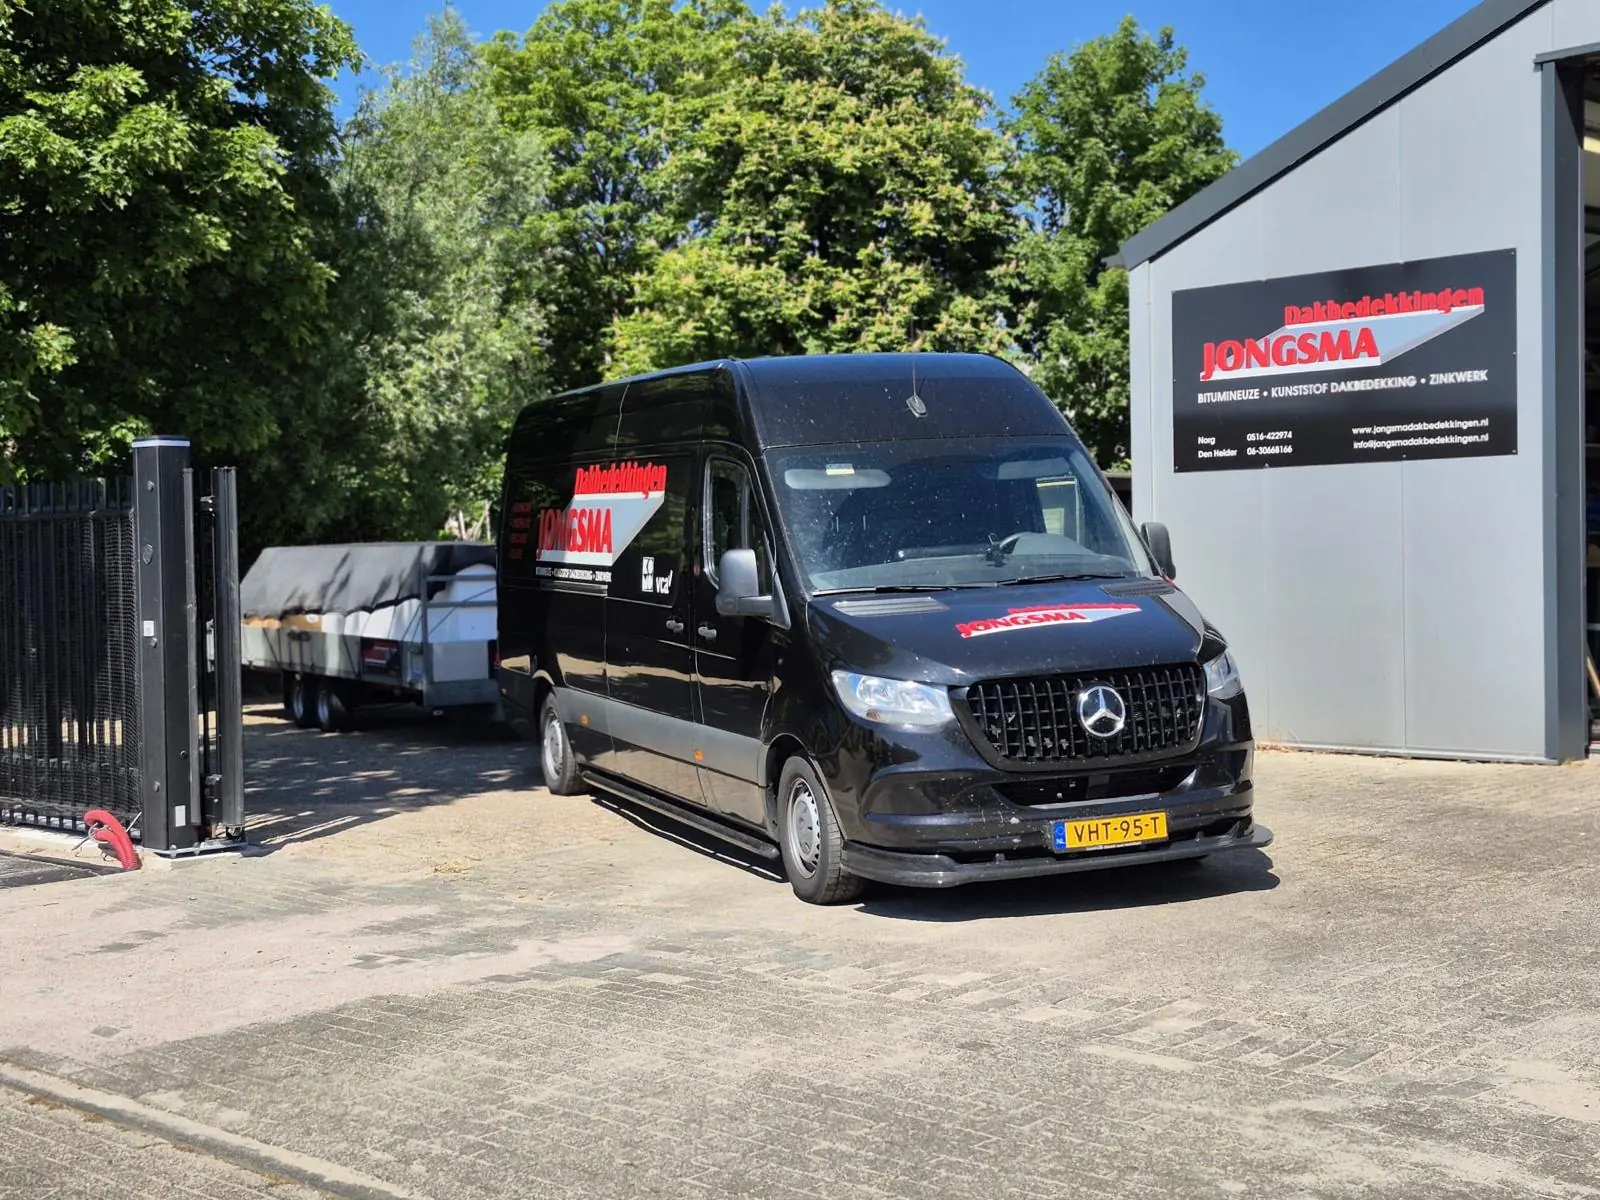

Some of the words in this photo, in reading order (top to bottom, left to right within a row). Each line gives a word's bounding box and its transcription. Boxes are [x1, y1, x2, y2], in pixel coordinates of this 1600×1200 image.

[1284, 287, 1484, 325] Dakbedekkingen
[1201, 327, 1380, 380] JONGSMA
[1197, 389, 1260, 404] BITUMINEUZE
[1271, 382, 1329, 398] KUNSTSTOF
[1330, 375, 1417, 393] DAKBEDEKKING
[1429, 369, 1489, 385] ZINKWERK
[1198, 450, 1213, 459] Den
[575, 461, 667, 500] Dakbedekkingen
[536, 508, 613, 561] JONGSMA
[956, 611, 1087, 636] JONGSMA
[1073, 816, 1160, 843] VHT-95-T
